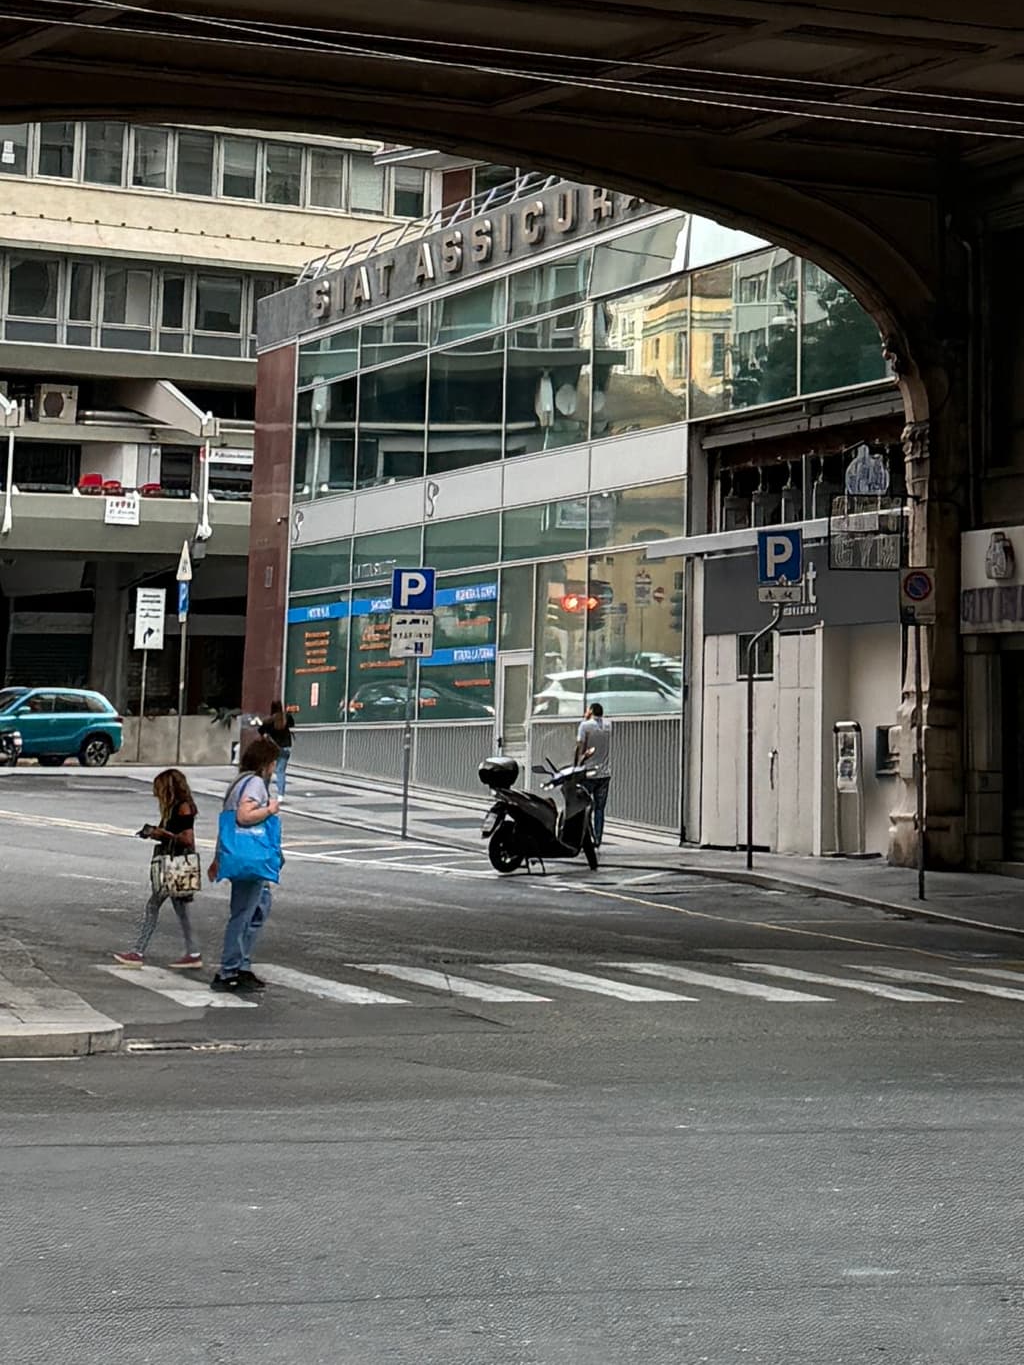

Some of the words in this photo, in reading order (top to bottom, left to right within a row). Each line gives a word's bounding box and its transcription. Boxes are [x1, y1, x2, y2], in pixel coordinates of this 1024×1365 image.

[312, 258, 395, 319] SIAT
[766, 536, 793, 578] P
[400, 572, 427, 607] P
